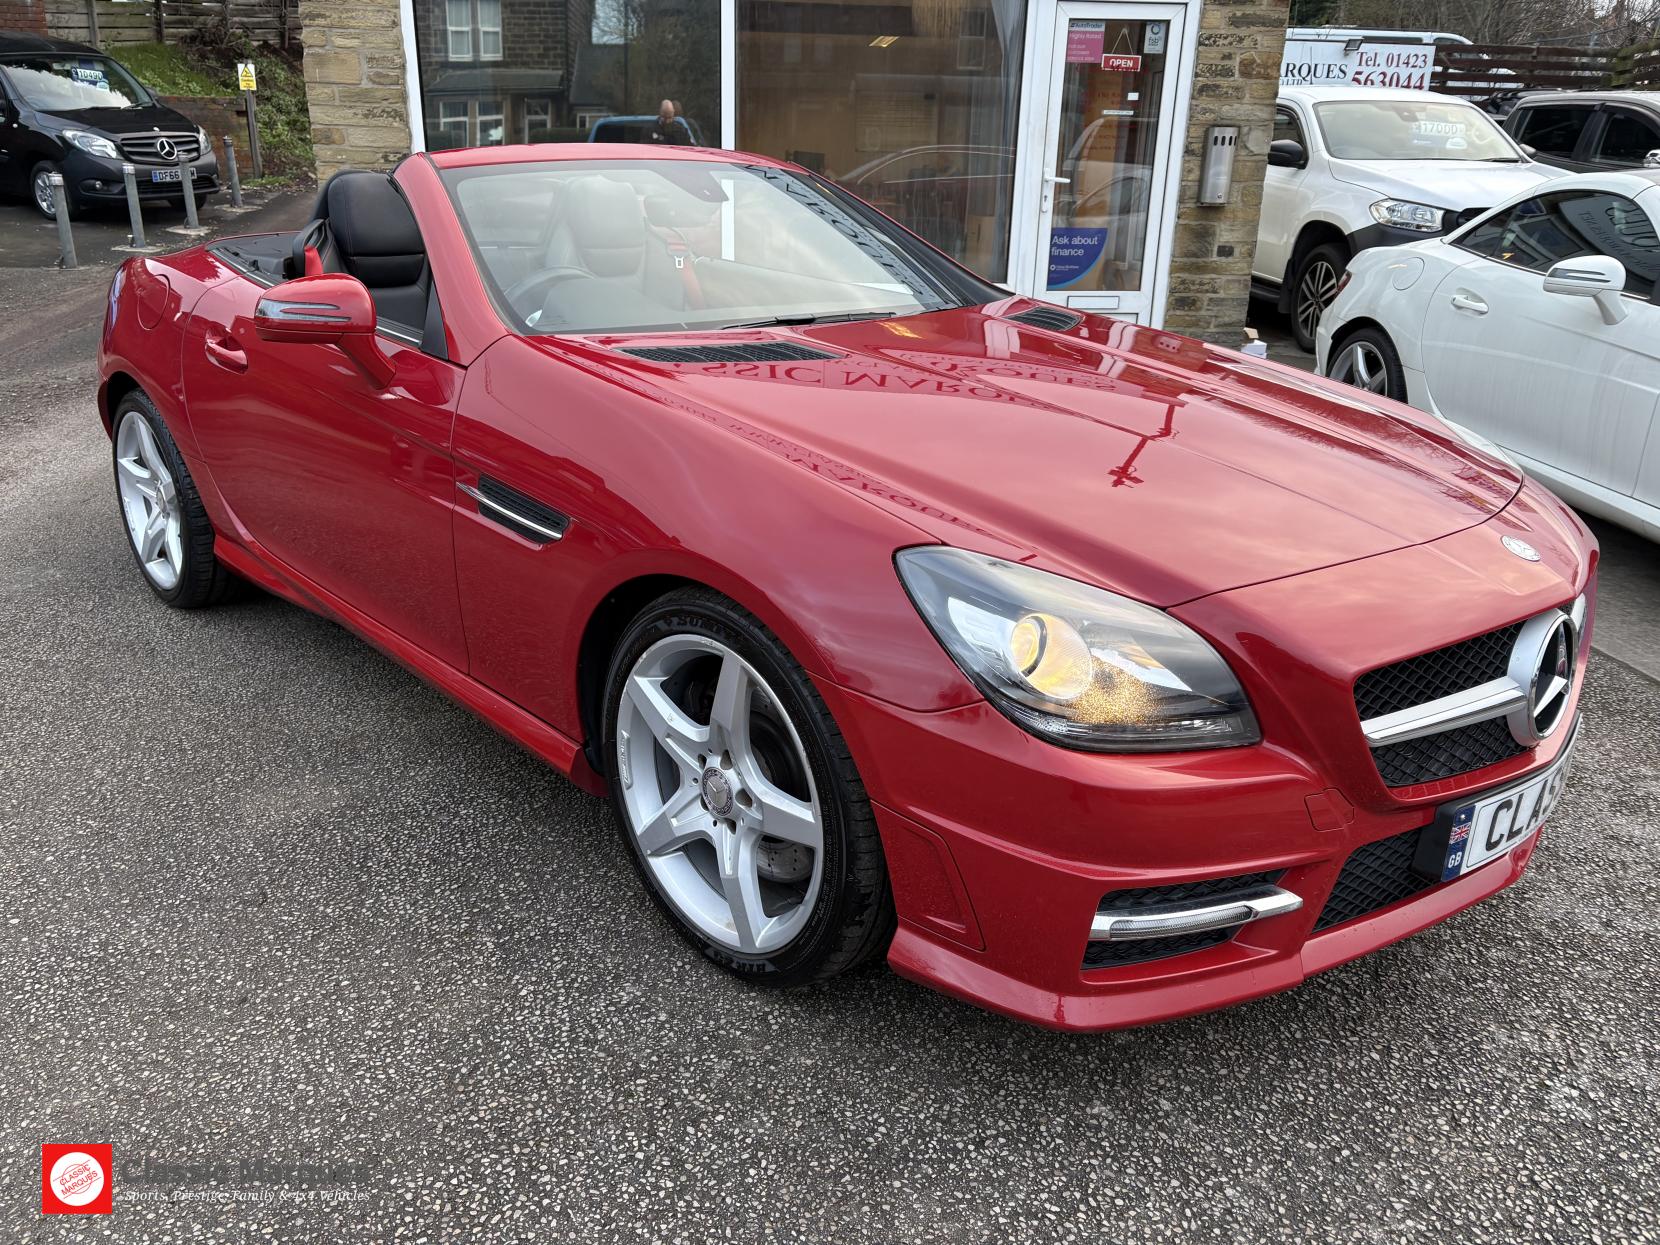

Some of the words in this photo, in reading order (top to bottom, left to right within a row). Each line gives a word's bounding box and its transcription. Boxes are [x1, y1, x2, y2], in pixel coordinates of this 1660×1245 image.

[1109, 58, 1134, 68] OPEN
[1357, 51, 1381, 67] Tel.
[1386, 52, 1428, 68] 01423
[1280, 62, 1348, 82] RQUES
[1351, 70, 1426, 91] 563044
[1051, 235, 1070, 245] Ask
[1071, 235, 1098, 245] about
[1051, 246, 1085, 256] finance
[1447, 851, 1462, 869] GB
